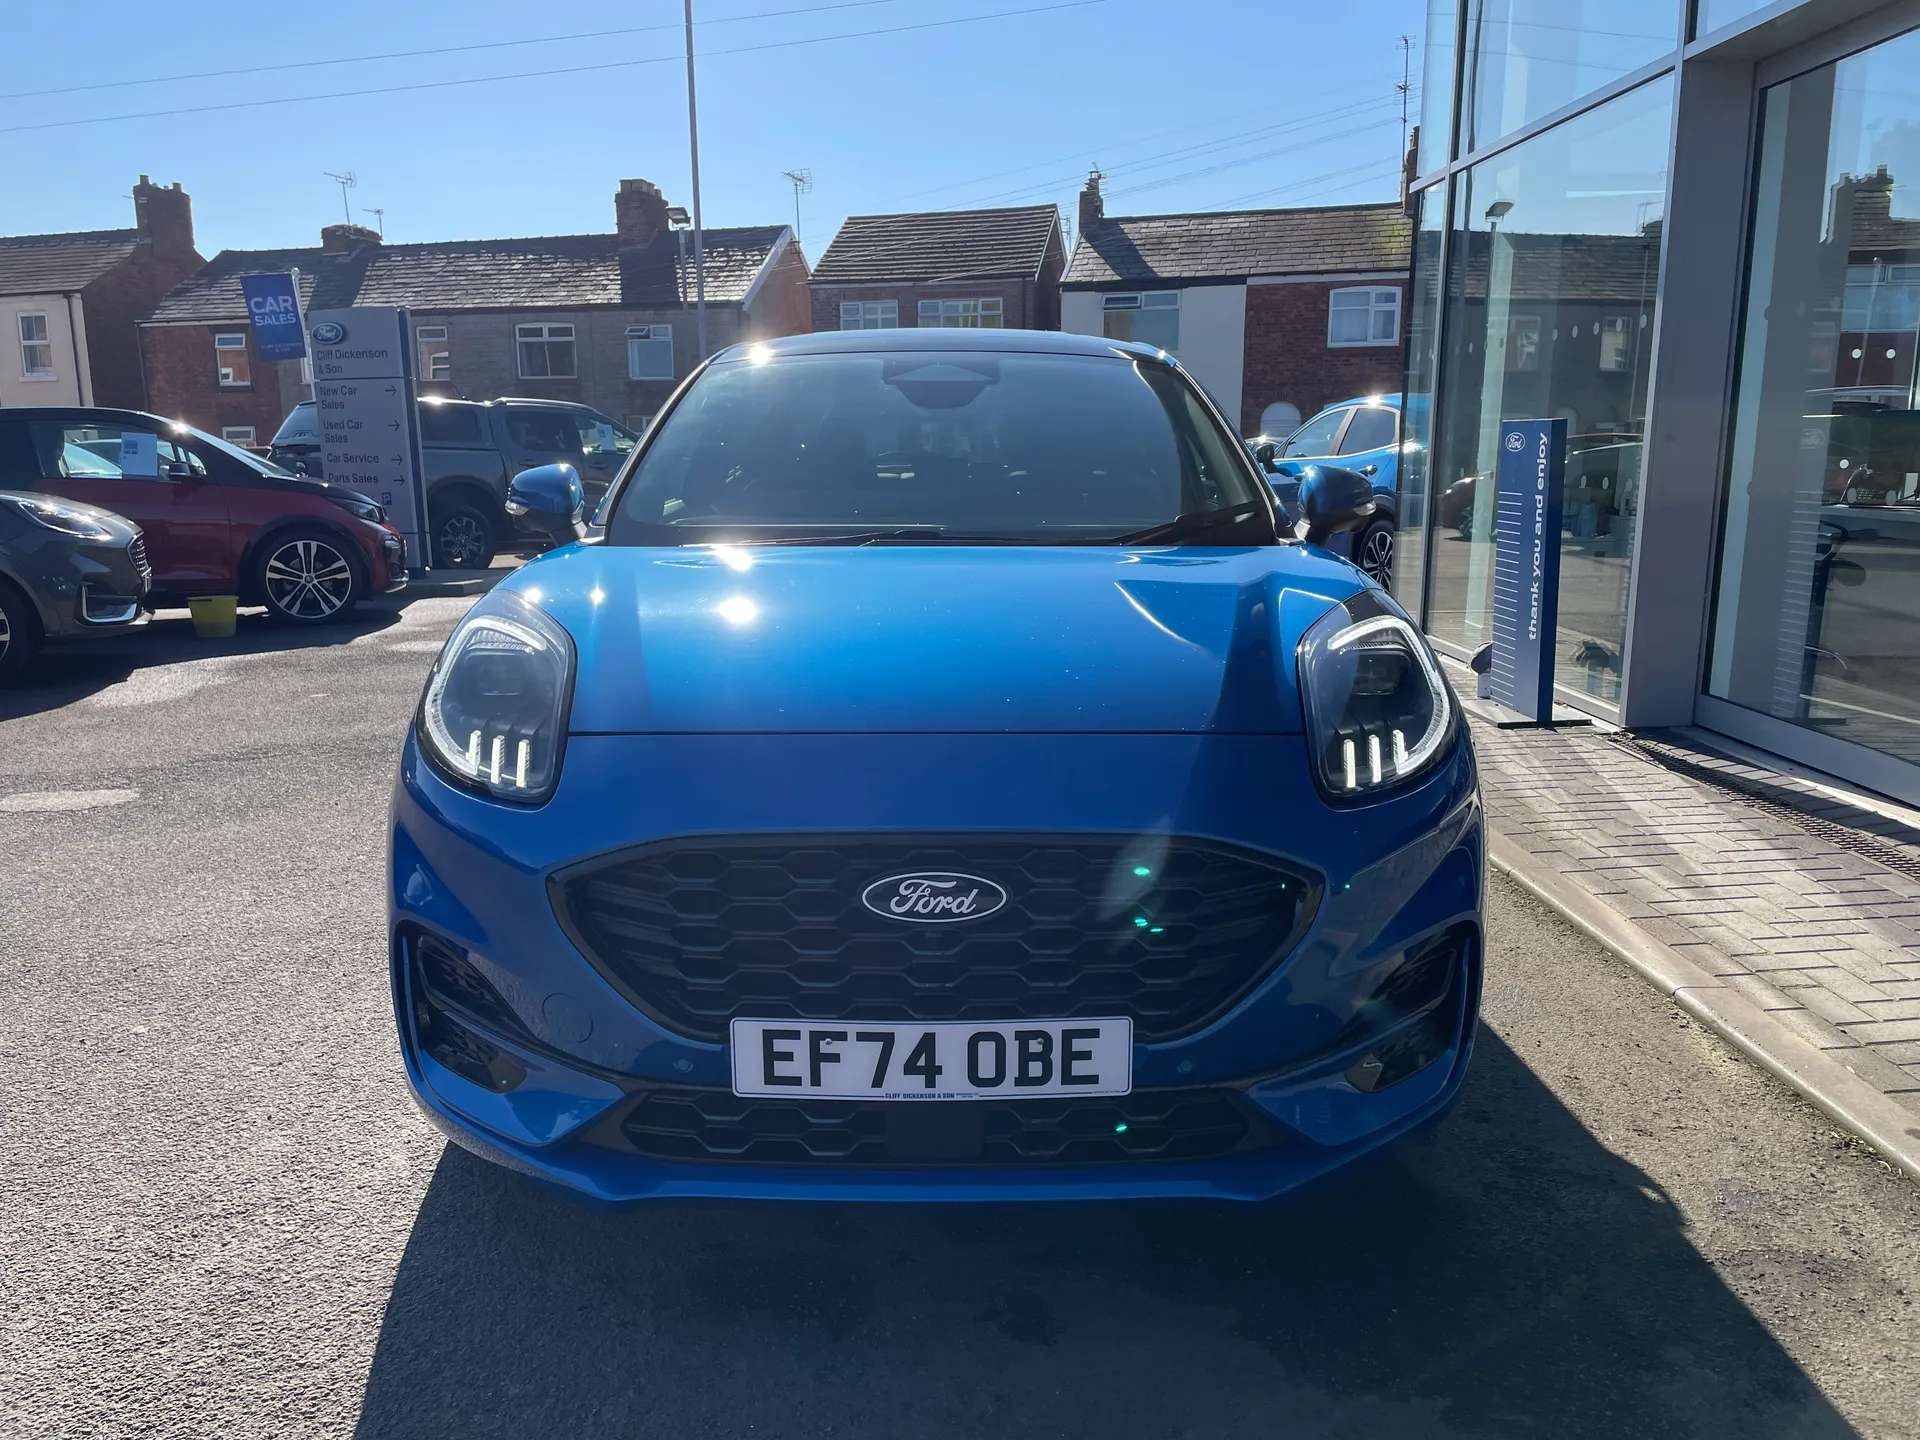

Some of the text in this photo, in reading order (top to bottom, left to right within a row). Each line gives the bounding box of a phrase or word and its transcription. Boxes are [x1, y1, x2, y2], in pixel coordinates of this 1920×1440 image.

[250, 295, 294, 313] CAR
[254, 312, 297, 326] SALES
[317, 349, 388, 360] Cliff Dickenson
[325, 363, 343, 374] Son
[320, 384, 357, 396] New Car
[321, 400, 345, 410] Sales
[323, 419, 363, 430] Used Car
[324, 433, 348, 443] Sales
[326, 453, 380, 464] Car Service
[351, 472, 379, 484] Sales
[1528, 432, 1548, 641] thank you and enjoy
[889, 879, 980, 914] Ford
[761, 1028, 943, 1089] EF74
